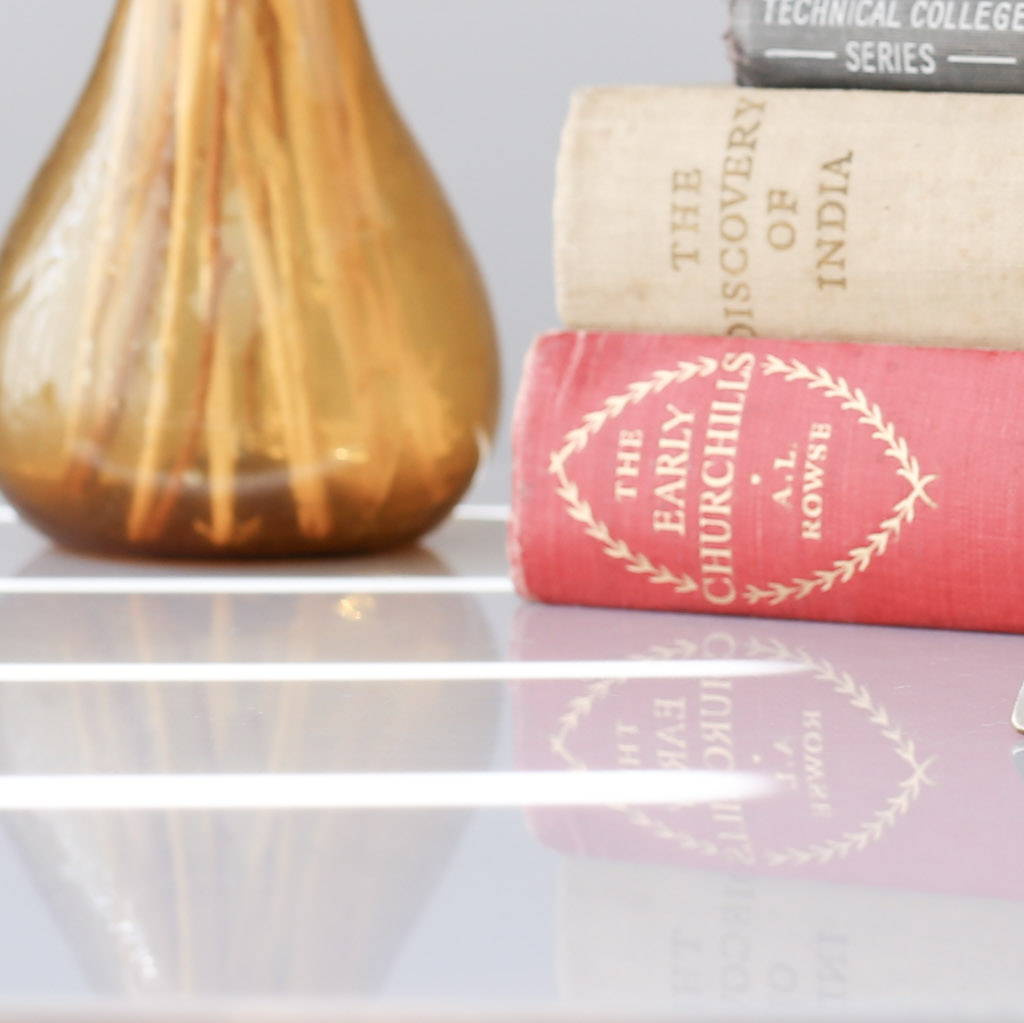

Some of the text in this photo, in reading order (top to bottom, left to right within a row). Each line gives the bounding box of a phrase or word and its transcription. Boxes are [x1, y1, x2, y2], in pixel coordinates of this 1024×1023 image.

[845, 41, 937, 75] SERIES
[671, 168, 703, 271] THE
[766, 188, 798, 252] OF
[816, 149, 853, 291] INDIA
[615, 429, 644, 502] THE
[653, 403, 695, 536] EARLY
[701, 351, 756, 605] CHURCHILLS
[772, 442, 799, 509] A.L.
[802, 422, 832, 541] ROWSE
